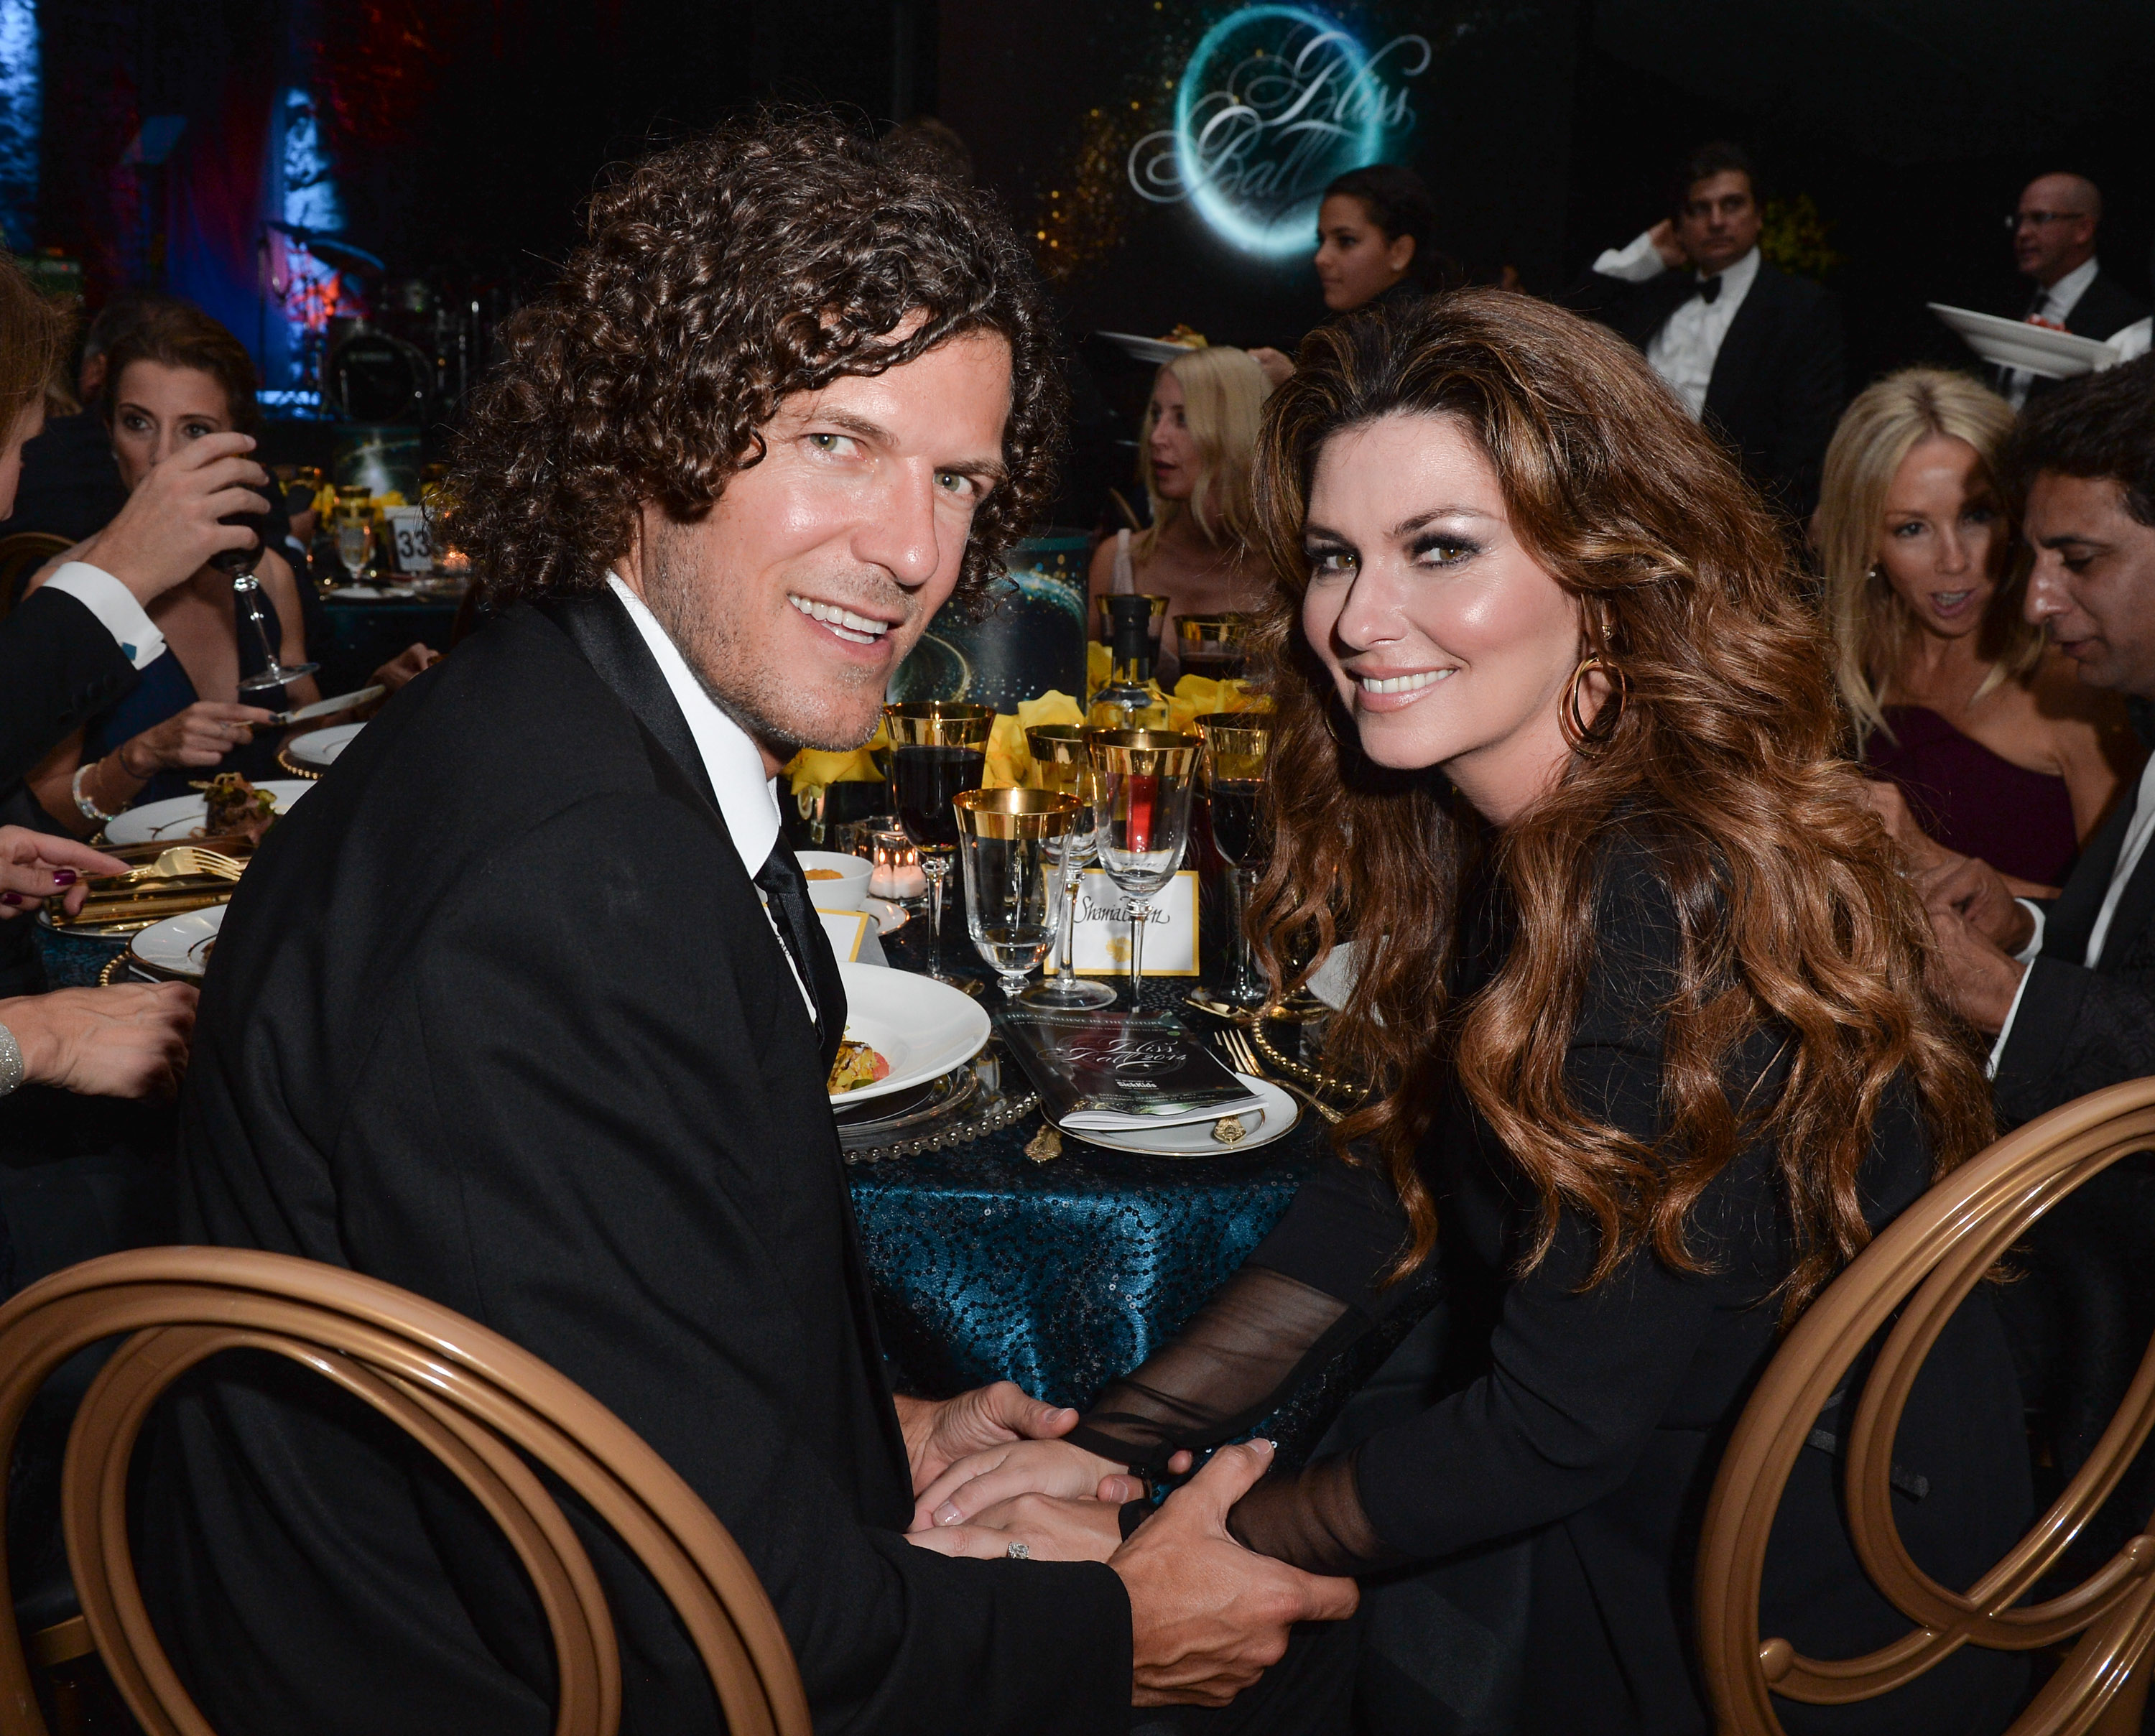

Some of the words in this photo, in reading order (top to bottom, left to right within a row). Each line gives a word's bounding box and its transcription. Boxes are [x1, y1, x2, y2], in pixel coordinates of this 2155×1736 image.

[399, 530, 430, 558] 33
[1073, 896, 1122, 924] Shania
[1098, 1038, 1178, 1054] Bliss
